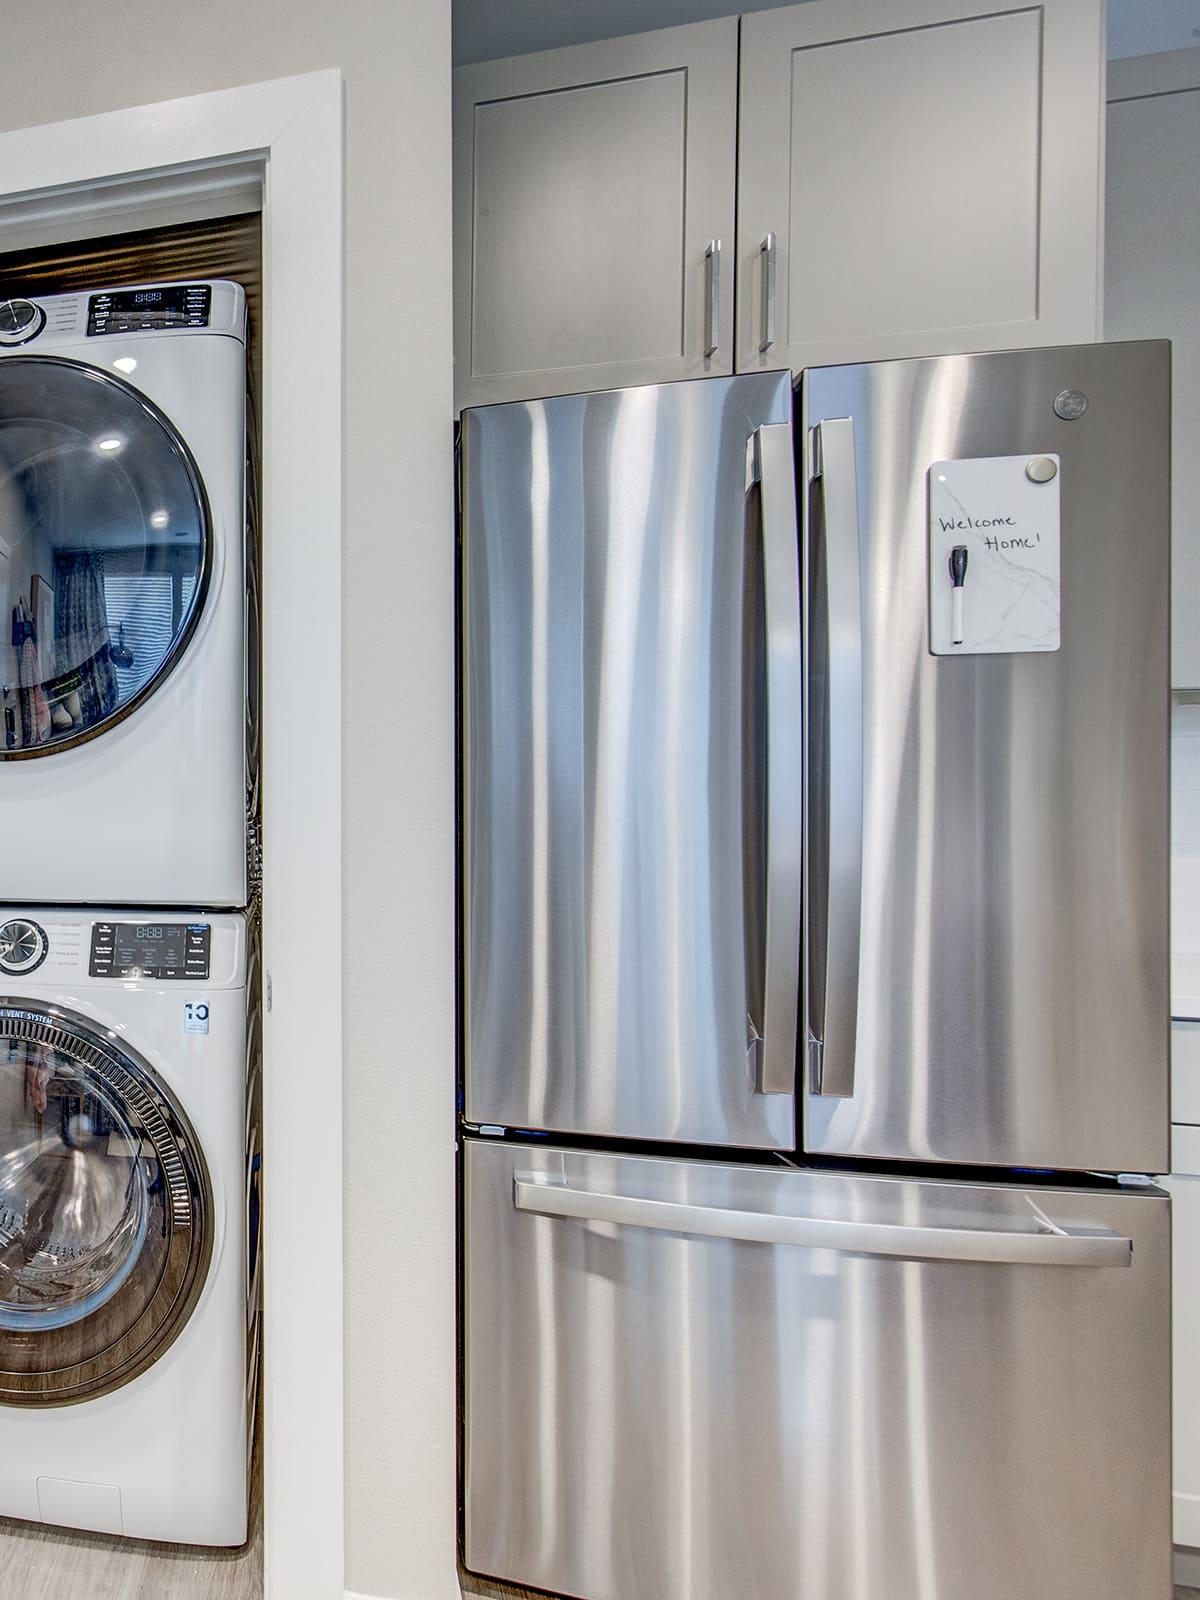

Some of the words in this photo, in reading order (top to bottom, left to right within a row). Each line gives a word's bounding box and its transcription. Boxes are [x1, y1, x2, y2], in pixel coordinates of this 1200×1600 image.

[938, 516, 1017, 532] Welcome
[983, 532, 1041, 552] Home!
[6, 1009, 24, 1019] VENT
[26, 1012, 53, 1025] SYSTEM
[185, 1003, 209, 1020] 10
